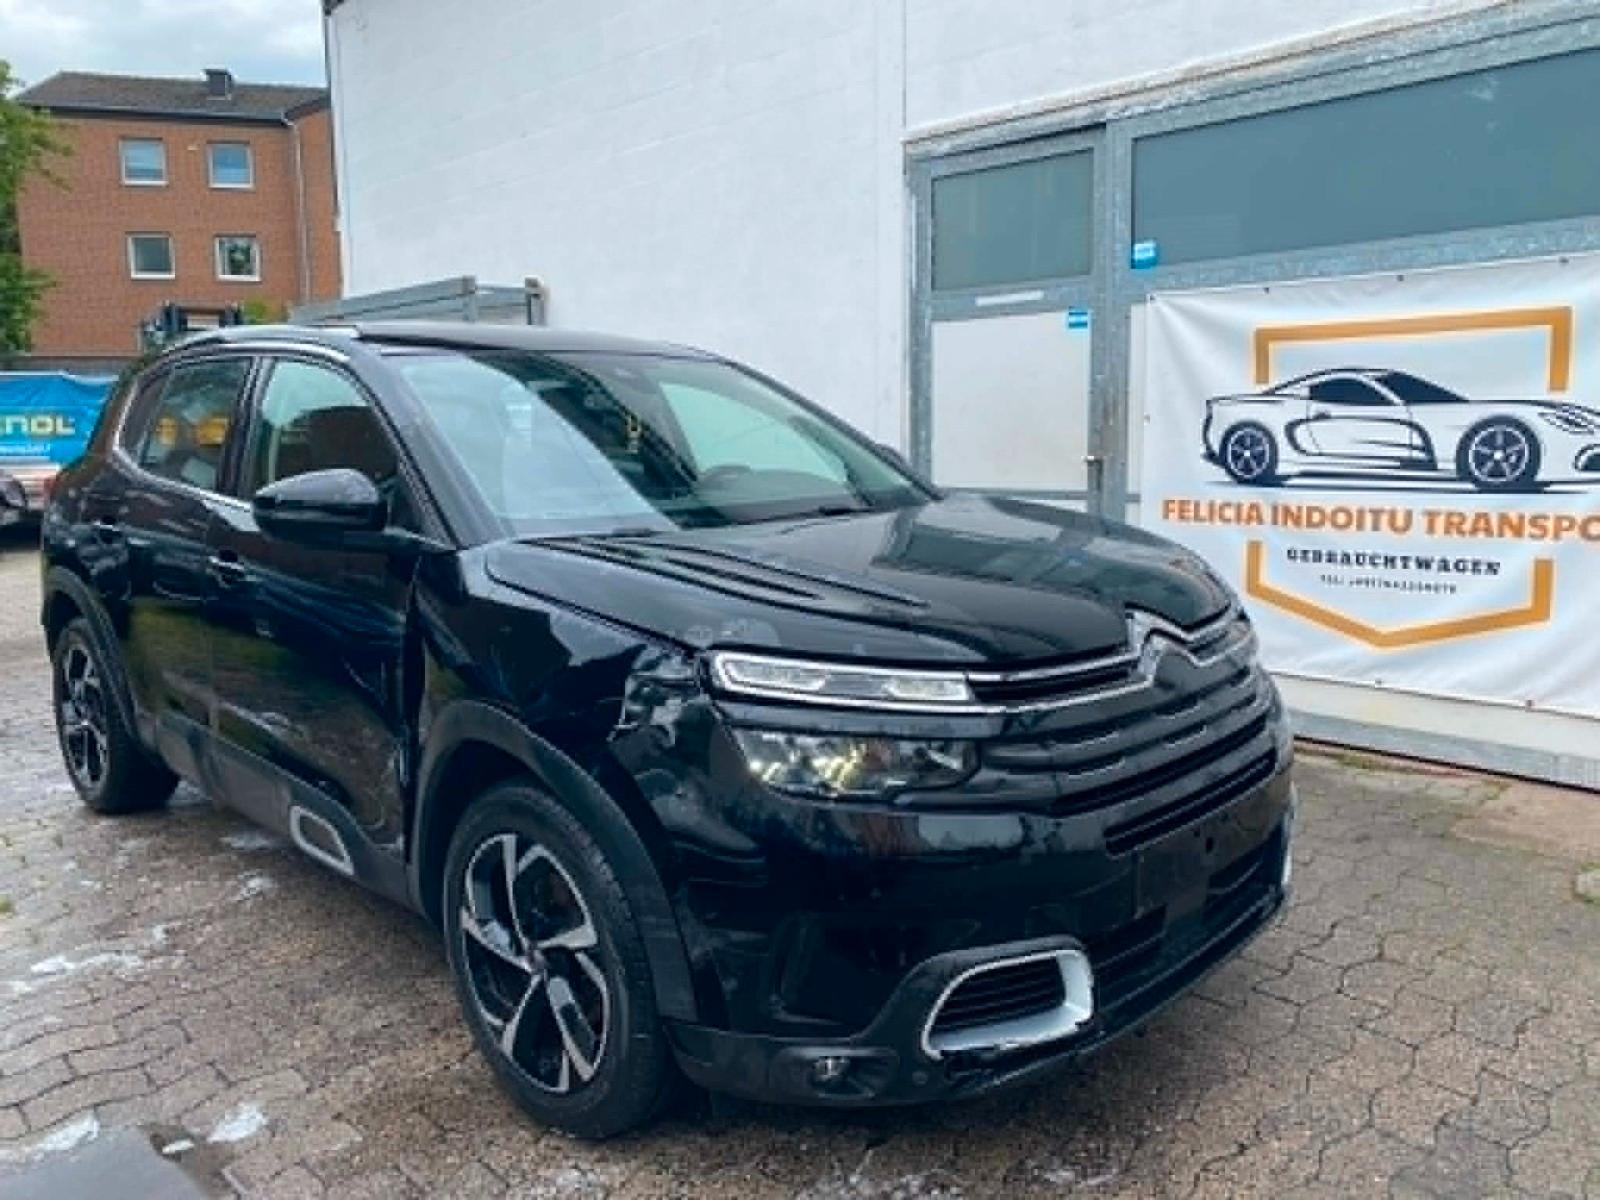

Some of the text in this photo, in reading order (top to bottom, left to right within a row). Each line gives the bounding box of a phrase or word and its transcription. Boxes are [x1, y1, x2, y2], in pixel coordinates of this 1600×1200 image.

[0, 414, 76, 435] NOL
[1162, 499, 1264, 526] FELICIA
[1271, 503, 1413, 534] INDOITU
[1286, 548, 1501, 576] GEBRAUCHTWAGEN
